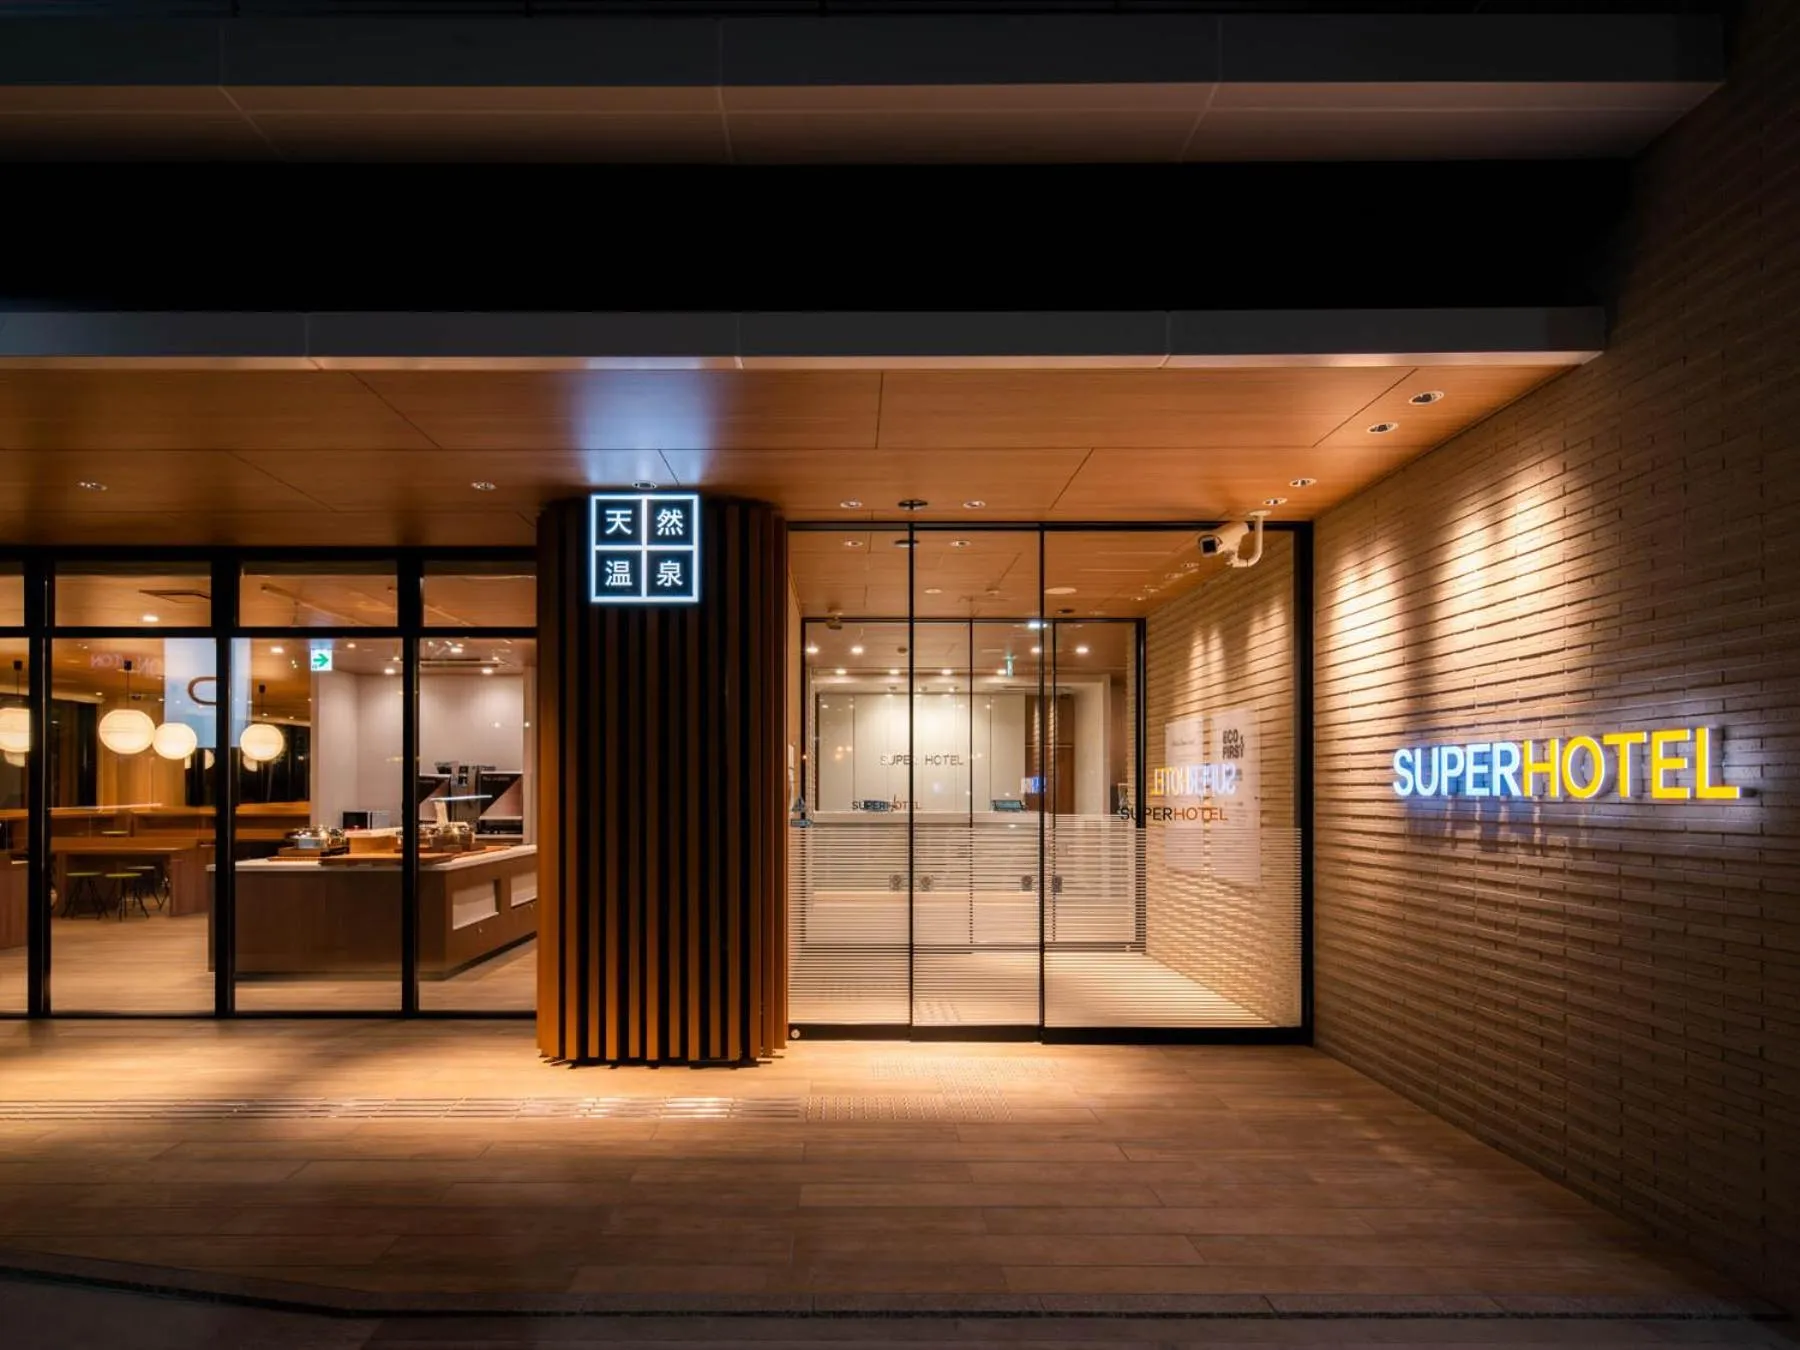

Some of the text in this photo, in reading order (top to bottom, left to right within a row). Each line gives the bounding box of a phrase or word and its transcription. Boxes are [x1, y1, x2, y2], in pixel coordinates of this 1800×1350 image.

[604, 508, 684, 536] 天然
[604, 560, 684, 587] 温泉
[1222, 728, 1239, 744] ECO
[880, 754, 964, 766] SUPE HOTEL
[1392, 725, 1741, 800] SUPERHOTEL
[851, 800, 922, 811] SUPEROTL
